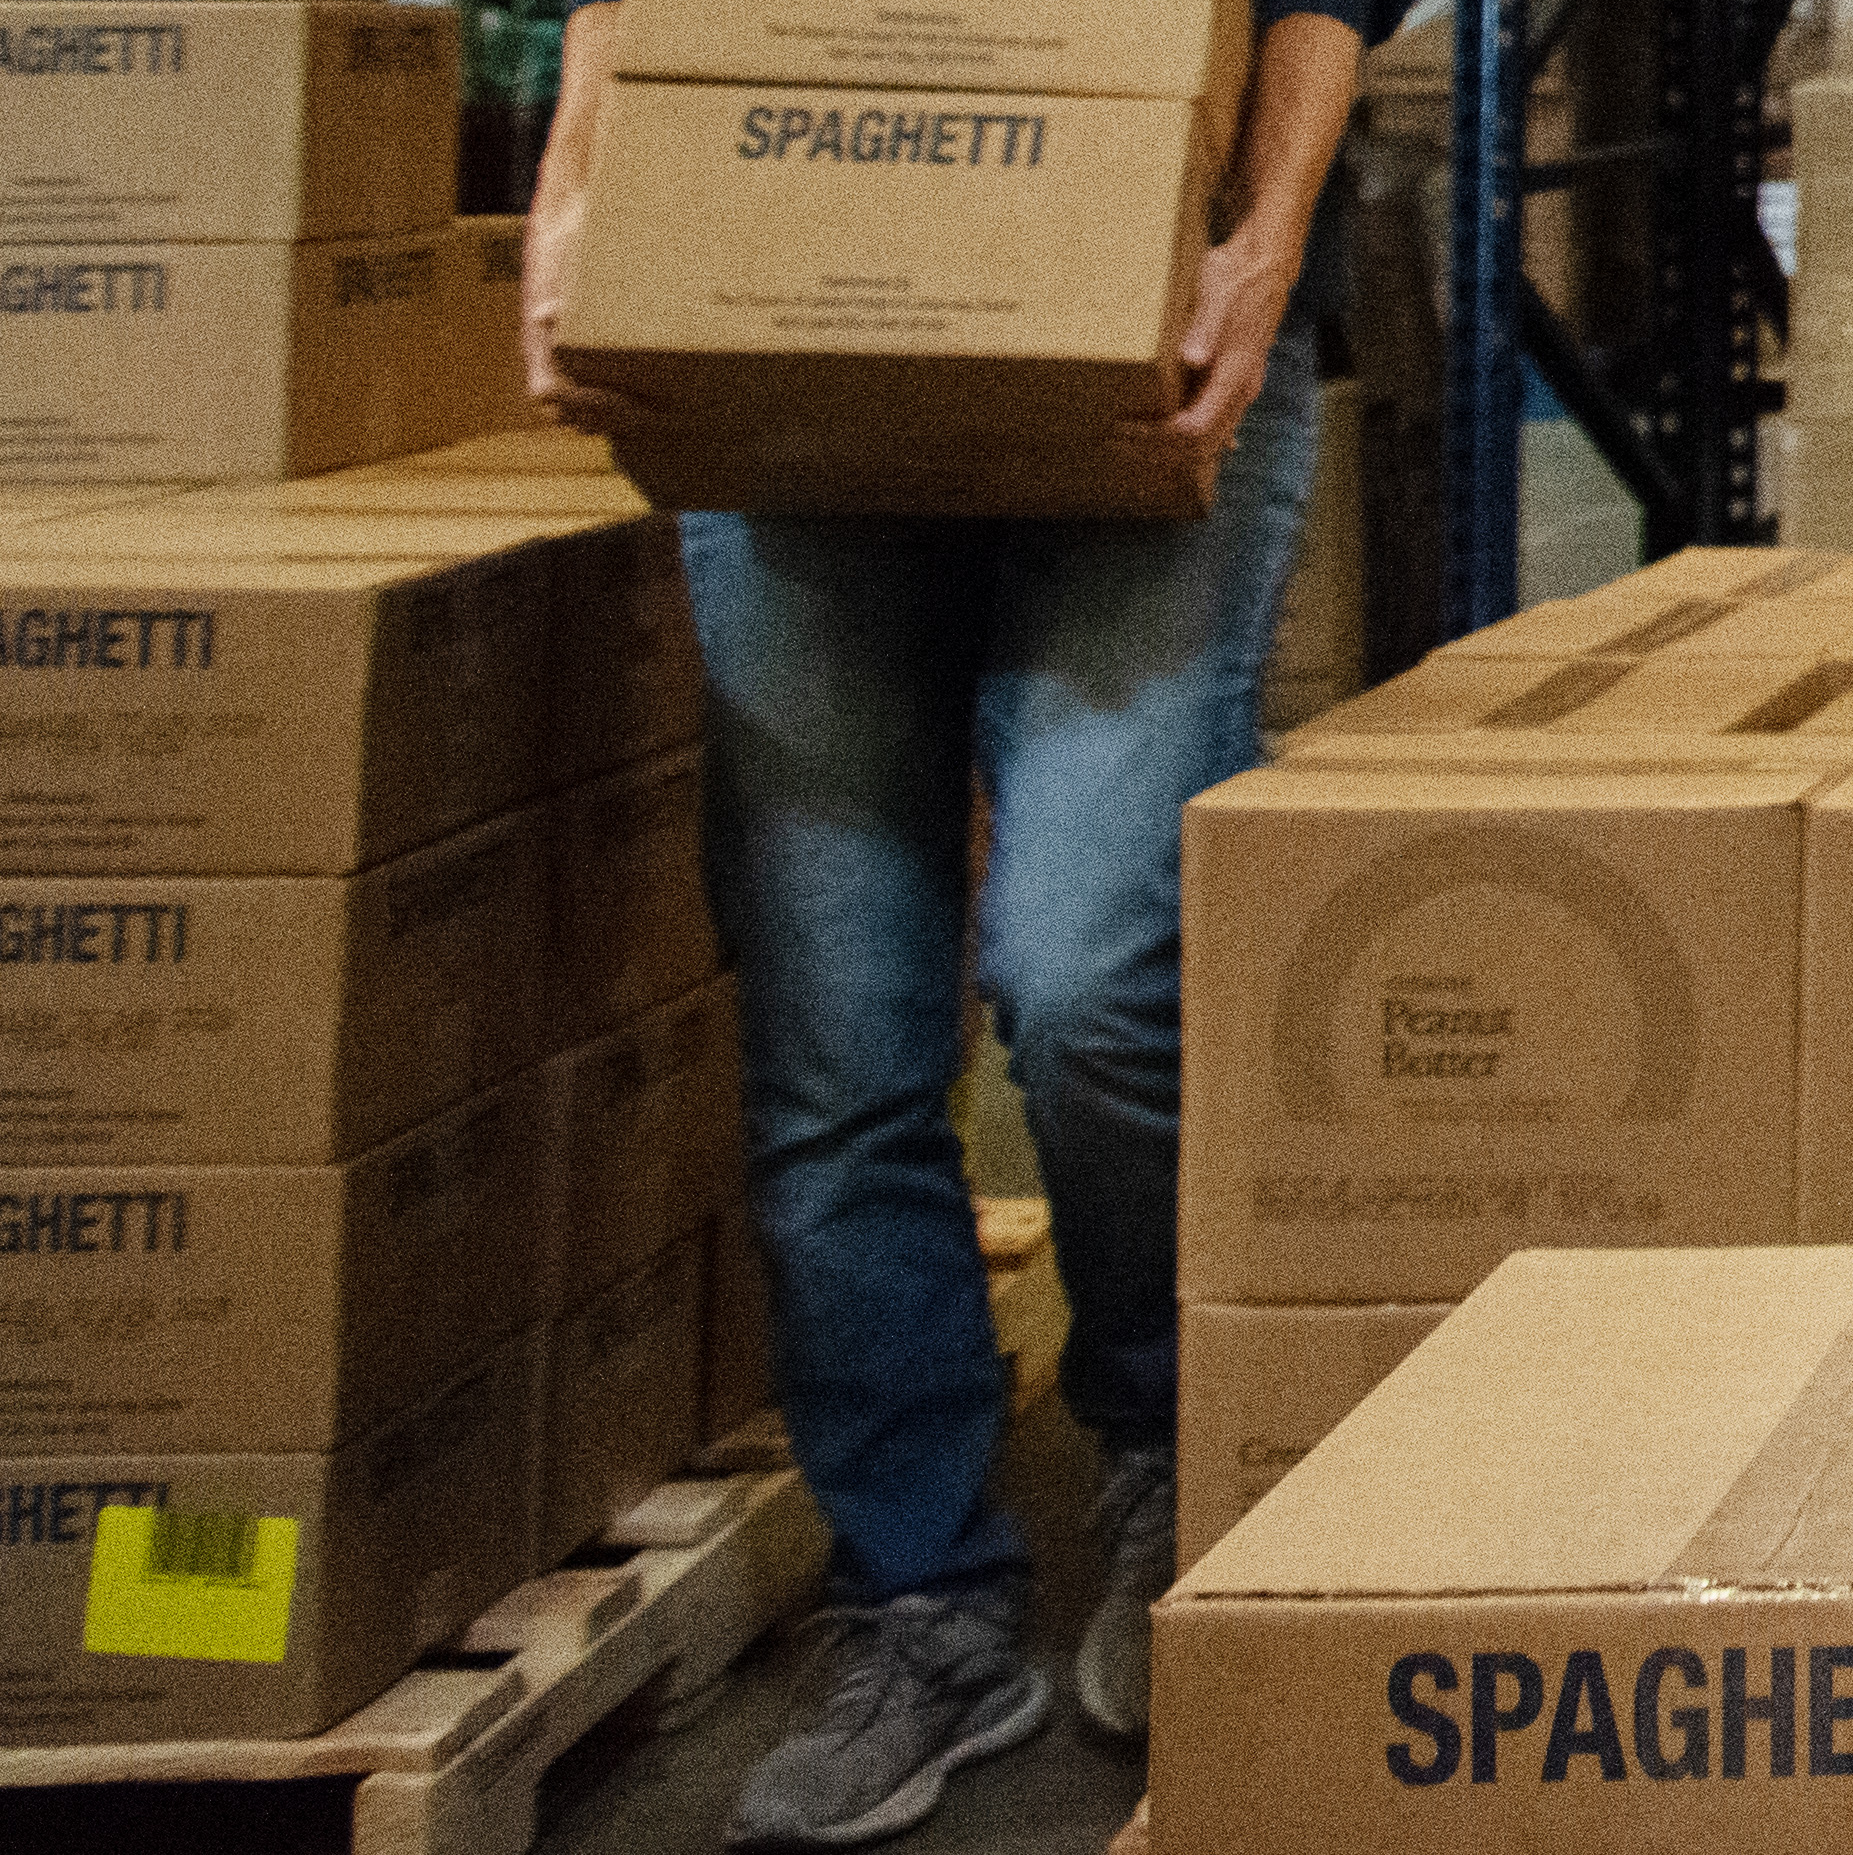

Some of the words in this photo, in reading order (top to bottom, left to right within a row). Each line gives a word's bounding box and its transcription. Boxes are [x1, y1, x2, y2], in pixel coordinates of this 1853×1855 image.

[734, 103, 1048, 170] SPAGHETTI
[1381, 996, 1516, 1037] Peanut
[1380, 1041, 1501, 1080] Butter
